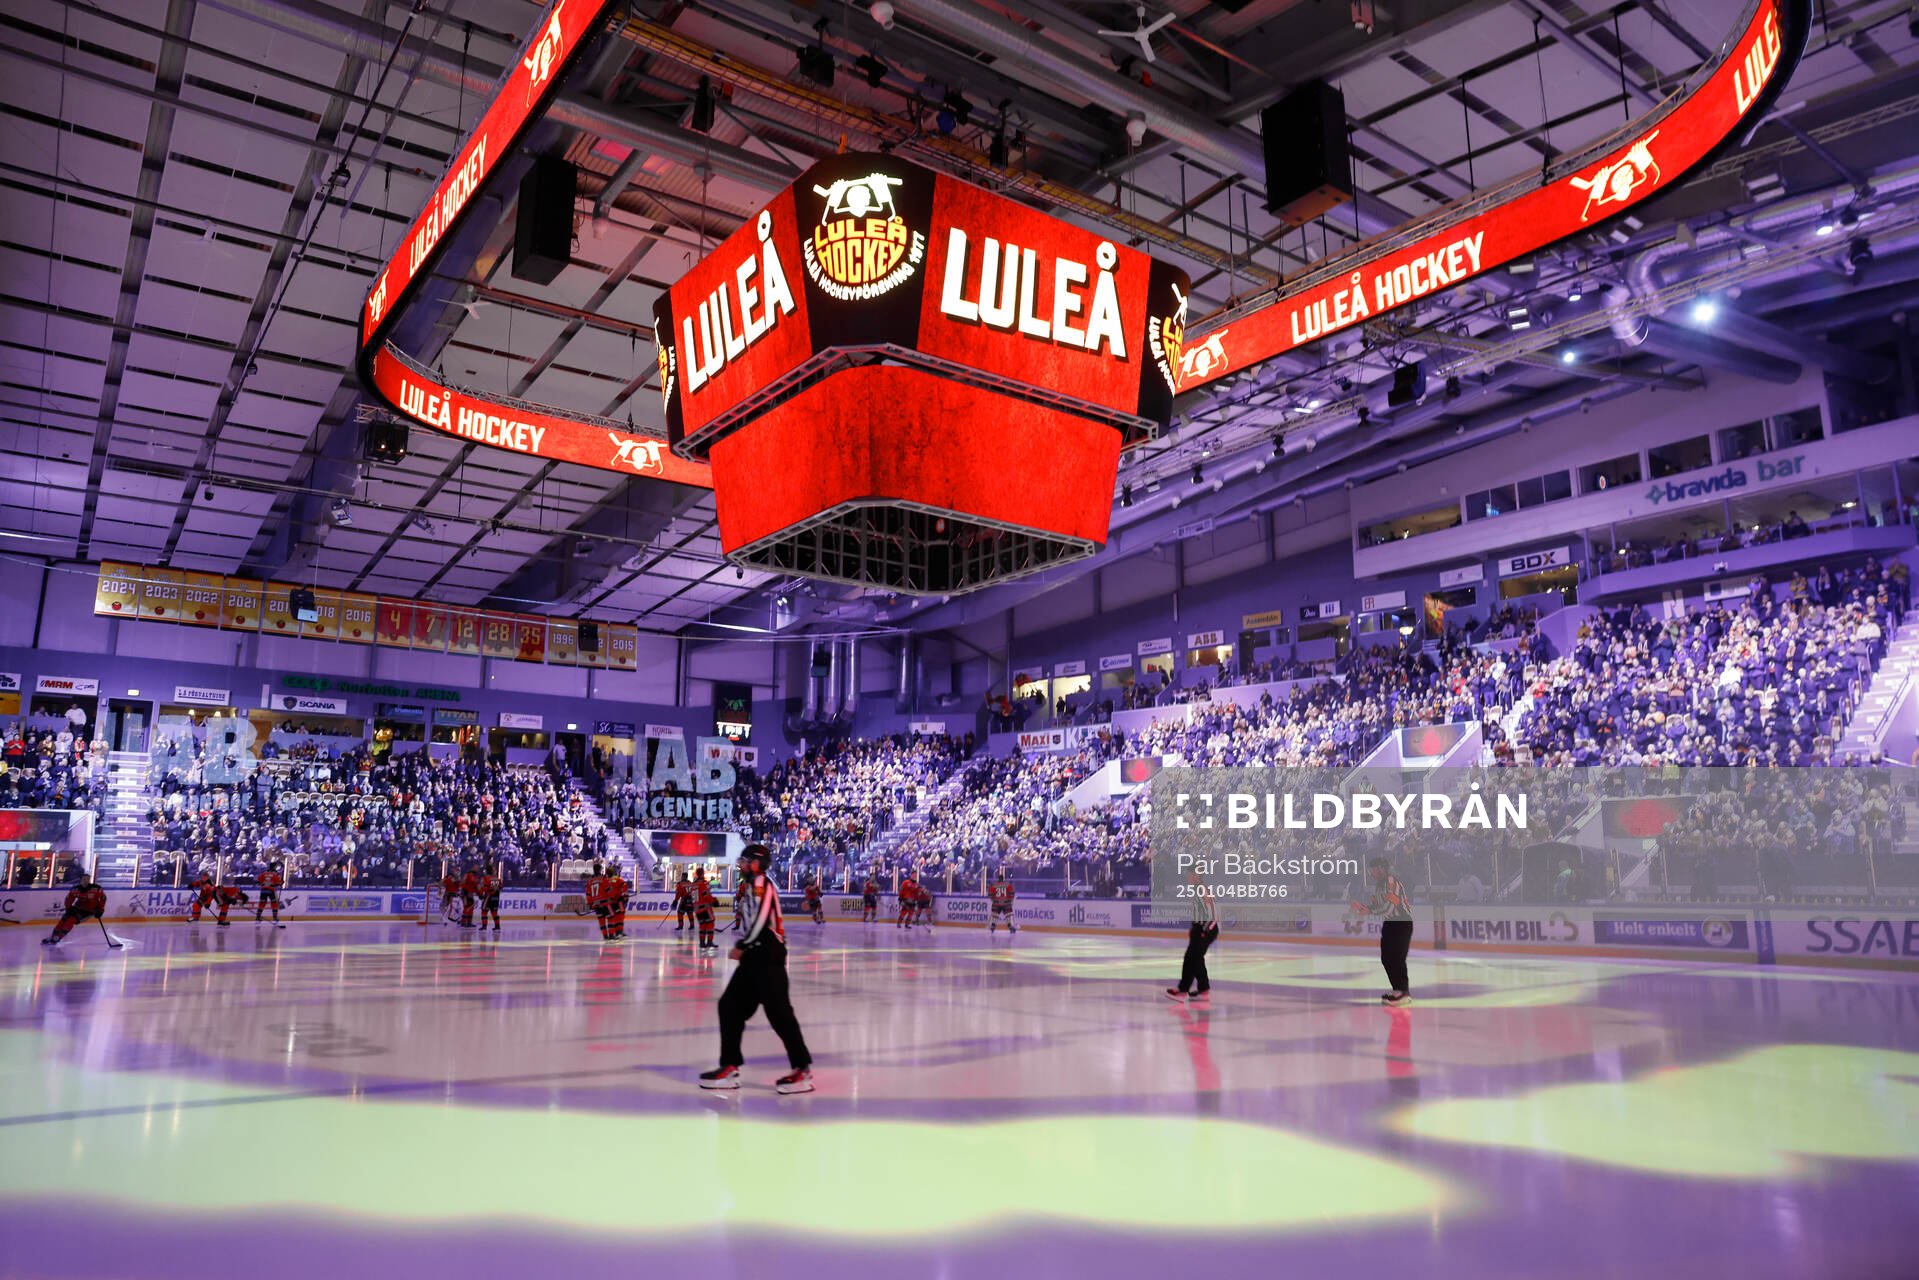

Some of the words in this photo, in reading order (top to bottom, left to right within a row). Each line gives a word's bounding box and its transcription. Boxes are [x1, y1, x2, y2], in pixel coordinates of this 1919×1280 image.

[409, 192, 439, 277] LULEÅ
[441, 133, 488, 233] HOCKEY
[815, 216, 907, 250] LULEÅ
[817, 238, 904, 284] HOCKEY
[941, 227, 1126, 357] LULEÅ
[1291, 271, 1369, 344] LULEÅ
[1374, 231, 1484, 311] HOCKEY
[683, 210, 794, 393] LULEÅ
[400, 379, 451, 431] LULEÅ
[458, 407, 545, 453] HOCKEY
[1665, 467, 1747, 502] bravida
[1757, 455, 1805, 482] bar
[1511, 551, 1556, 571] BDX
[101, 580, 136, 595] 2024
[145, 585, 178, 599] 2023
[186, 590, 218, 604] 2022
[228, 594, 257, 609] 2021
[269, 600, 289, 613] 201
[316, 605, 335, 618] 018
[345, 609, 371, 622] 2016
[389, 609, 400, 630] 4
[426, 615, 436, 633] 7
[457, 618, 473, 638] 12
[488, 622, 510, 641] 28
[520, 626, 541, 645] 35
[552, 633, 574, 645] 1996
[1194, 633, 1218, 645] ABB
[613, 639, 633, 650] 2015
[44, 680, 73, 689] MRM
[299, 700, 336, 710] SCANIA
[440, 710, 477, 720] TITAN
[1021, 734, 1049, 746] MAXI
[590, 883, 599, 897] 17
[499, 898, 537, 910] PERÄ
[947, 902, 969, 911] COOP
[1451, 918, 1511, 940] NIEMI
[1516, 919, 1548, 941] BIL
[1614, 921, 1644, 935] Helt
[1648, 922, 1697, 937] enkelt
